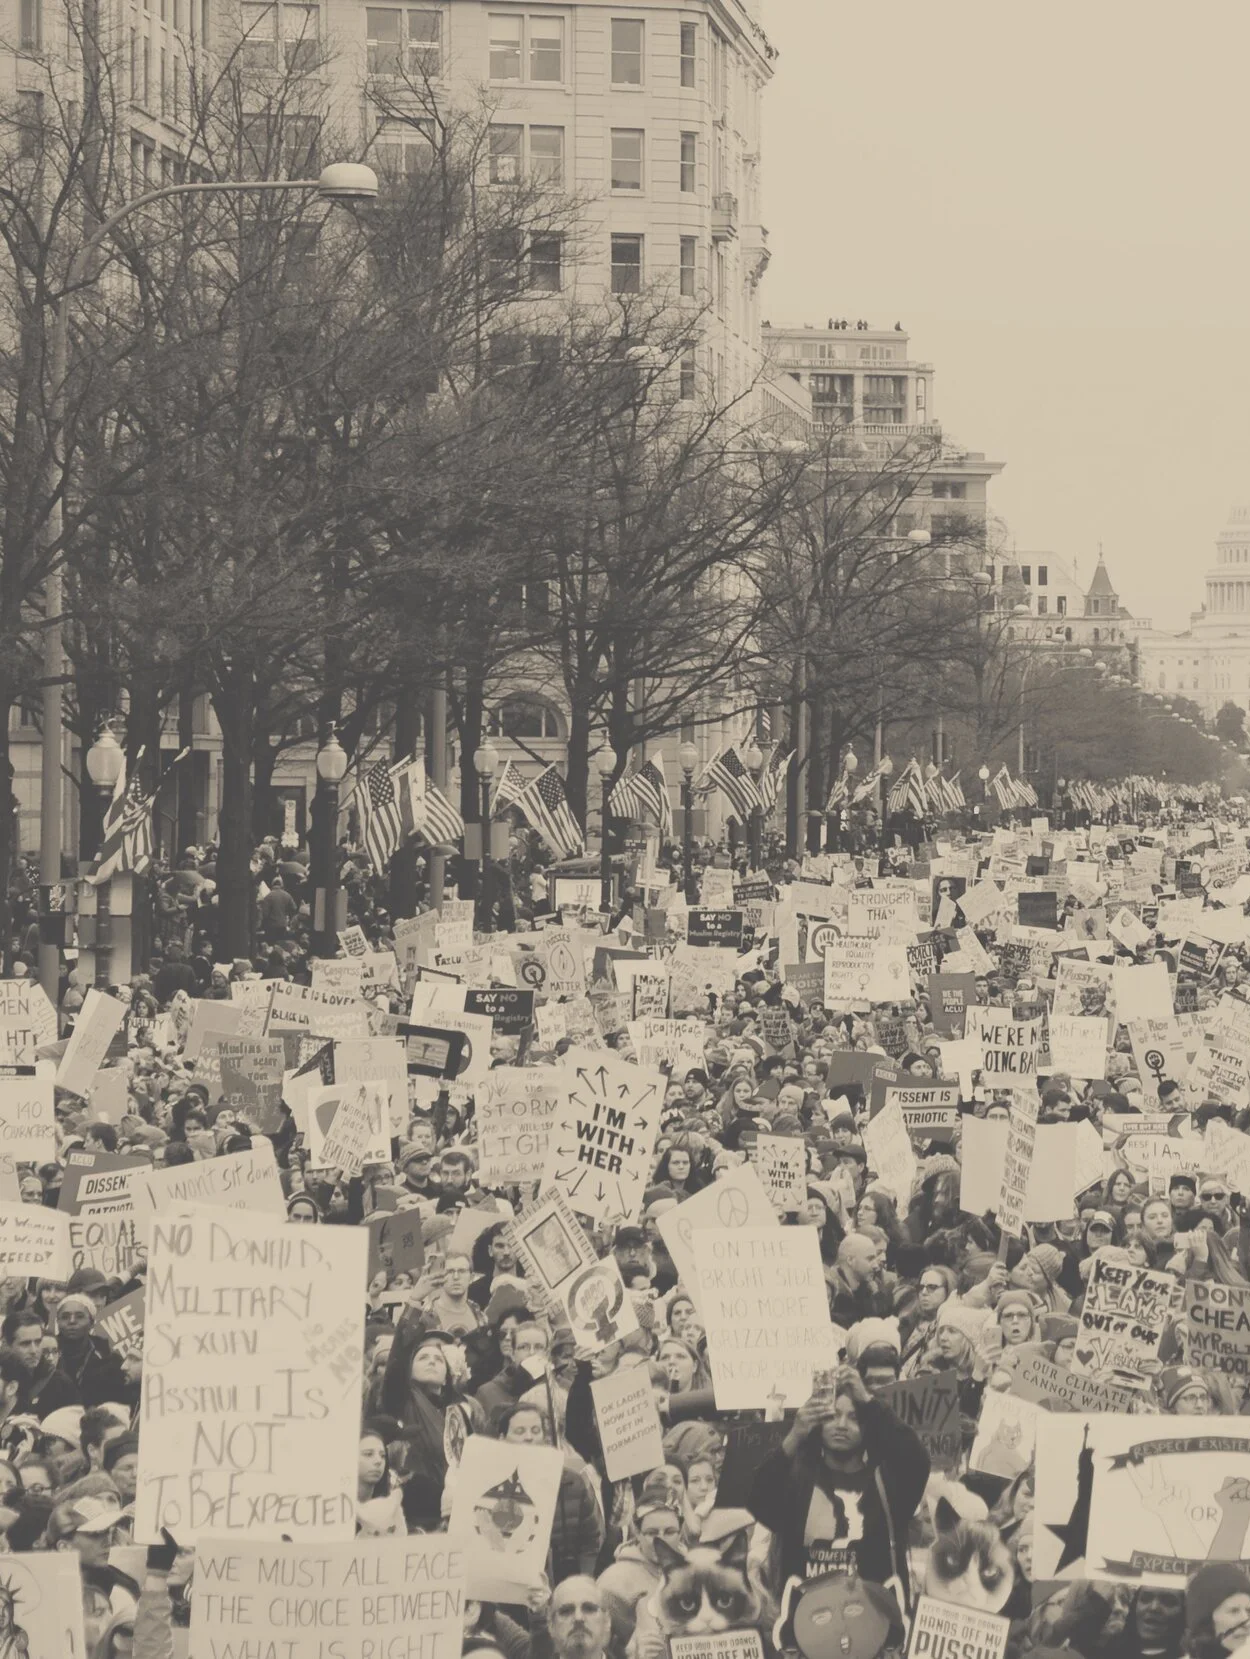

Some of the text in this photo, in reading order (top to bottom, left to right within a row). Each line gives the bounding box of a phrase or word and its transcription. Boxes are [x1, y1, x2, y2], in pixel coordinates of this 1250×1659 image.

[851, 891, 910, 906] STRONGER
[699, 913, 732, 922] SAY NO
[551, 980, 581, 992] MATTER
[476, 994, 497, 1003] SAY
[944, 1006, 964, 1014] ACLU
[981, 1023, 1025, 1047] WE'RE
[1209, 1048, 1243, 1067] TRUTH
[940, 1090, 951, 1102] IS
[17, 1101, 43, 1119] 140
[482, 1099, 559, 1119] STORM
[592, 1102, 628, 1131] I'M
[576, 1119, 636, 1157] WITH
[577, 1144, 624, 1175] HER
[773, 1159, 790, 1170] I'M
[767, 1169, 797, 1180] WITH
[770, 1179, 794, 1190] HER
[69, 1219, 142, 1249] EQUAL
[153, 1223, 194, 1257] NO
[712, 1239, 791, 1260] ON THE
[701, 1267, 817, 1290] BRIGHT SIDE
[1094, 1259, 1170, 1295] KEEP YOUR
[147, 1264, 313, 1321] MILITARY
[720, 1296, 810, 1318] NO MORE
[1096, 1285, 1169, 1326] LAWS
[709, 1328, 780, 1351] GRIZZLY
[1082, 1312, 1112, 1331] OUT
[1130, 1325, 1160, 1345] OUR
[1022, 1368, 1077, 1404] CANNOT
[1031, 1359, 1129, 1404] OUR CLIMATE
[274, 1367, 331, 1421] IS
[600, 1400, 616, 1415] OK
[602, 1400, 651, 1428] NOW LET'S
[615, 1416, 644, 1436] GET IN
[192, 1420, 286, 1473] NOT
[606, 1422, 657, 1454] FORMATION
[1134, 1438, 1191, 1459] RESPECT
[1190, 1506, 1219, 1523] OR
[807, 1549, 857, 1562] WOMEN'S
[1131, 1555, 1191, 1575] EXPECT
[197, 1551, 464, 1589] WE MUST ALL FACE
[198, 1588, 462, 1629] THE CHOICE BETWEEN
[919, 1613, 1002, 1648] HANDS OFF MY
